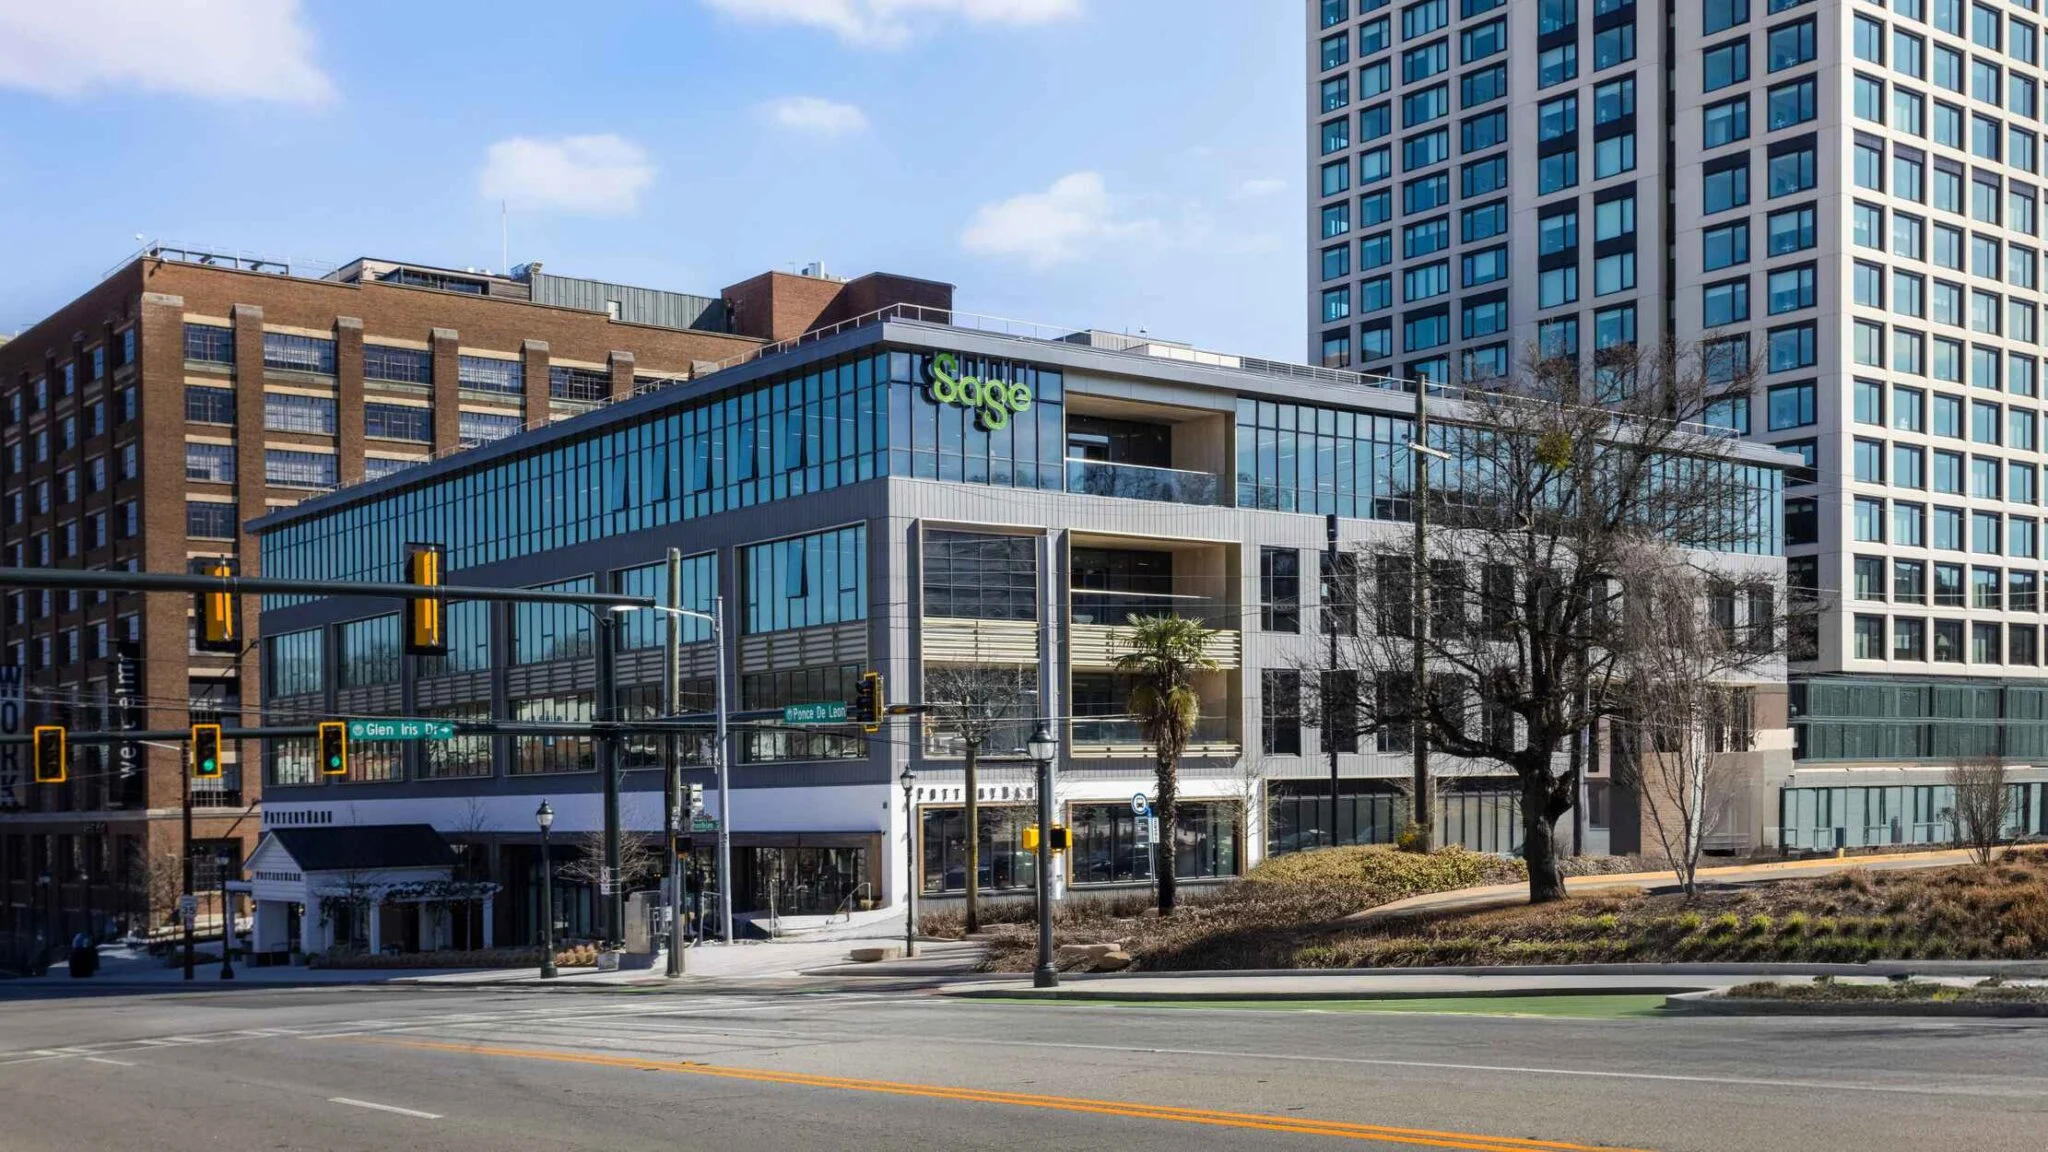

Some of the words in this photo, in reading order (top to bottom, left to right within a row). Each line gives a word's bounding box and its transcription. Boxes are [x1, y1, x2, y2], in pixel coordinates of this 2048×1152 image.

[934, 353, 1032, 430] Sage
[115, 662, 135, 709] elm
[366, 723, 394, 736] Glen
[401, 723, 418, 736] Iris
[425, 723, 438, 735] Dr
[793, 707, 814, 720] Ponce
[816, 705, 826, 719] De
[829, 704, 846, 718] Leon
[120, 713, 136, 778] wet
